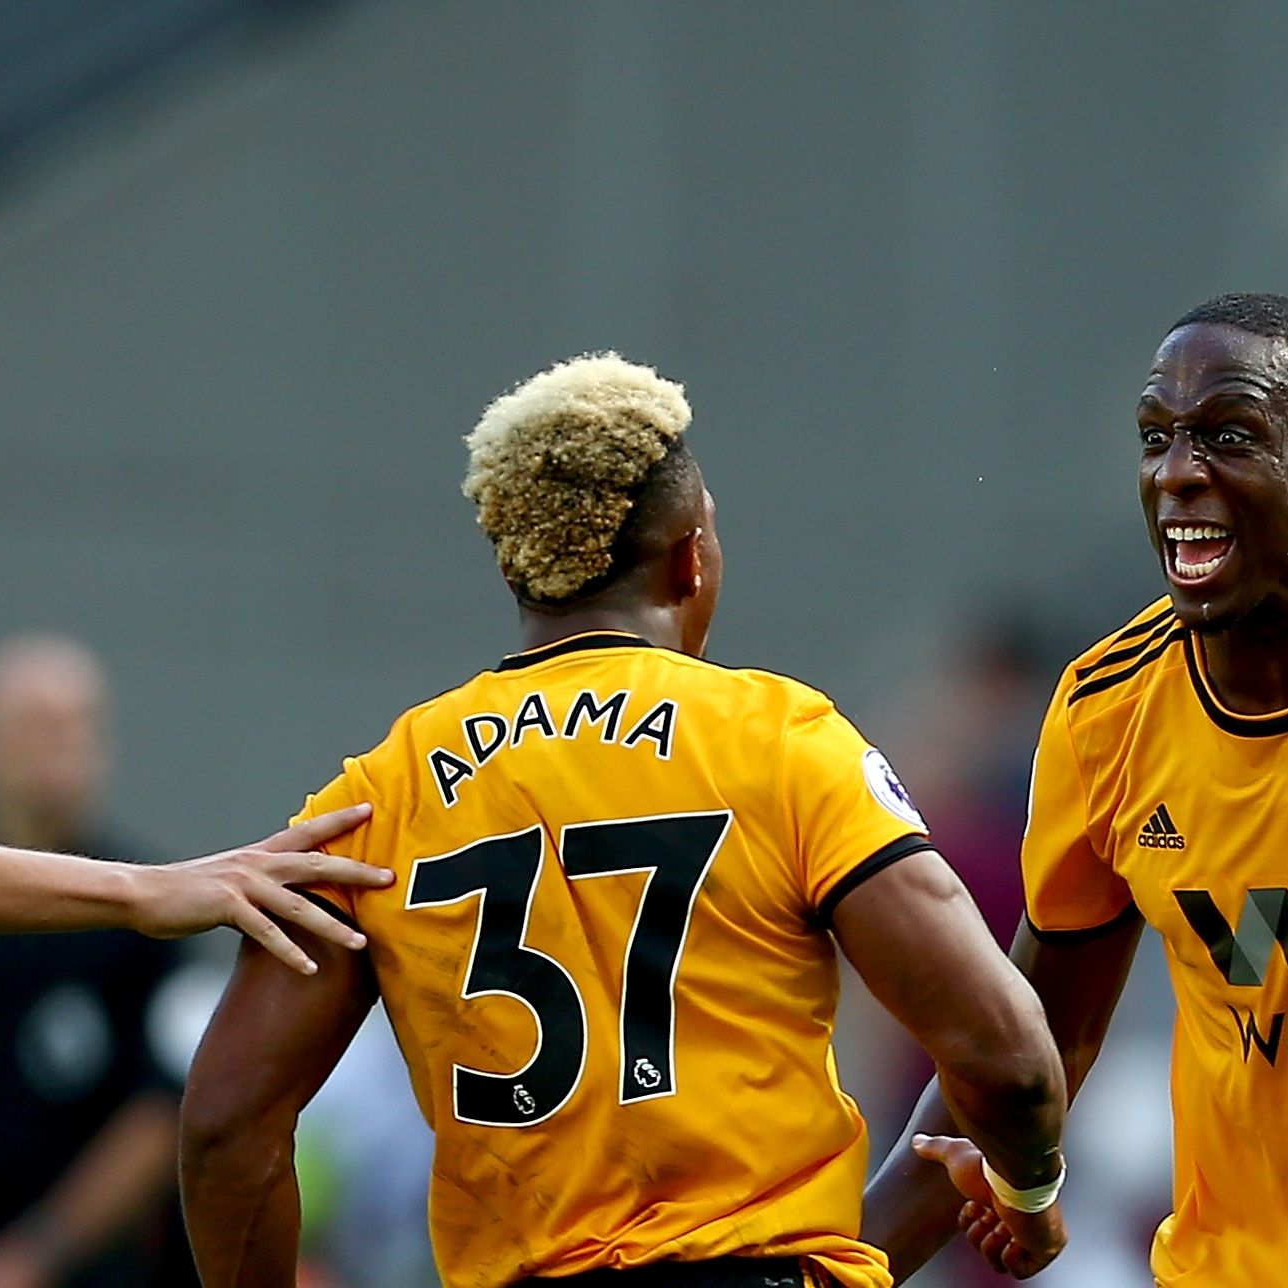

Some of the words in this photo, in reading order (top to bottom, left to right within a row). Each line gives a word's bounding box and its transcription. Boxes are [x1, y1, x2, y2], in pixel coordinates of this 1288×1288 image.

[429, 688, 679, 808] ADAMA
[1138, 832, 1186, 850] adidas
[405, 808, 733, 1128] 37
